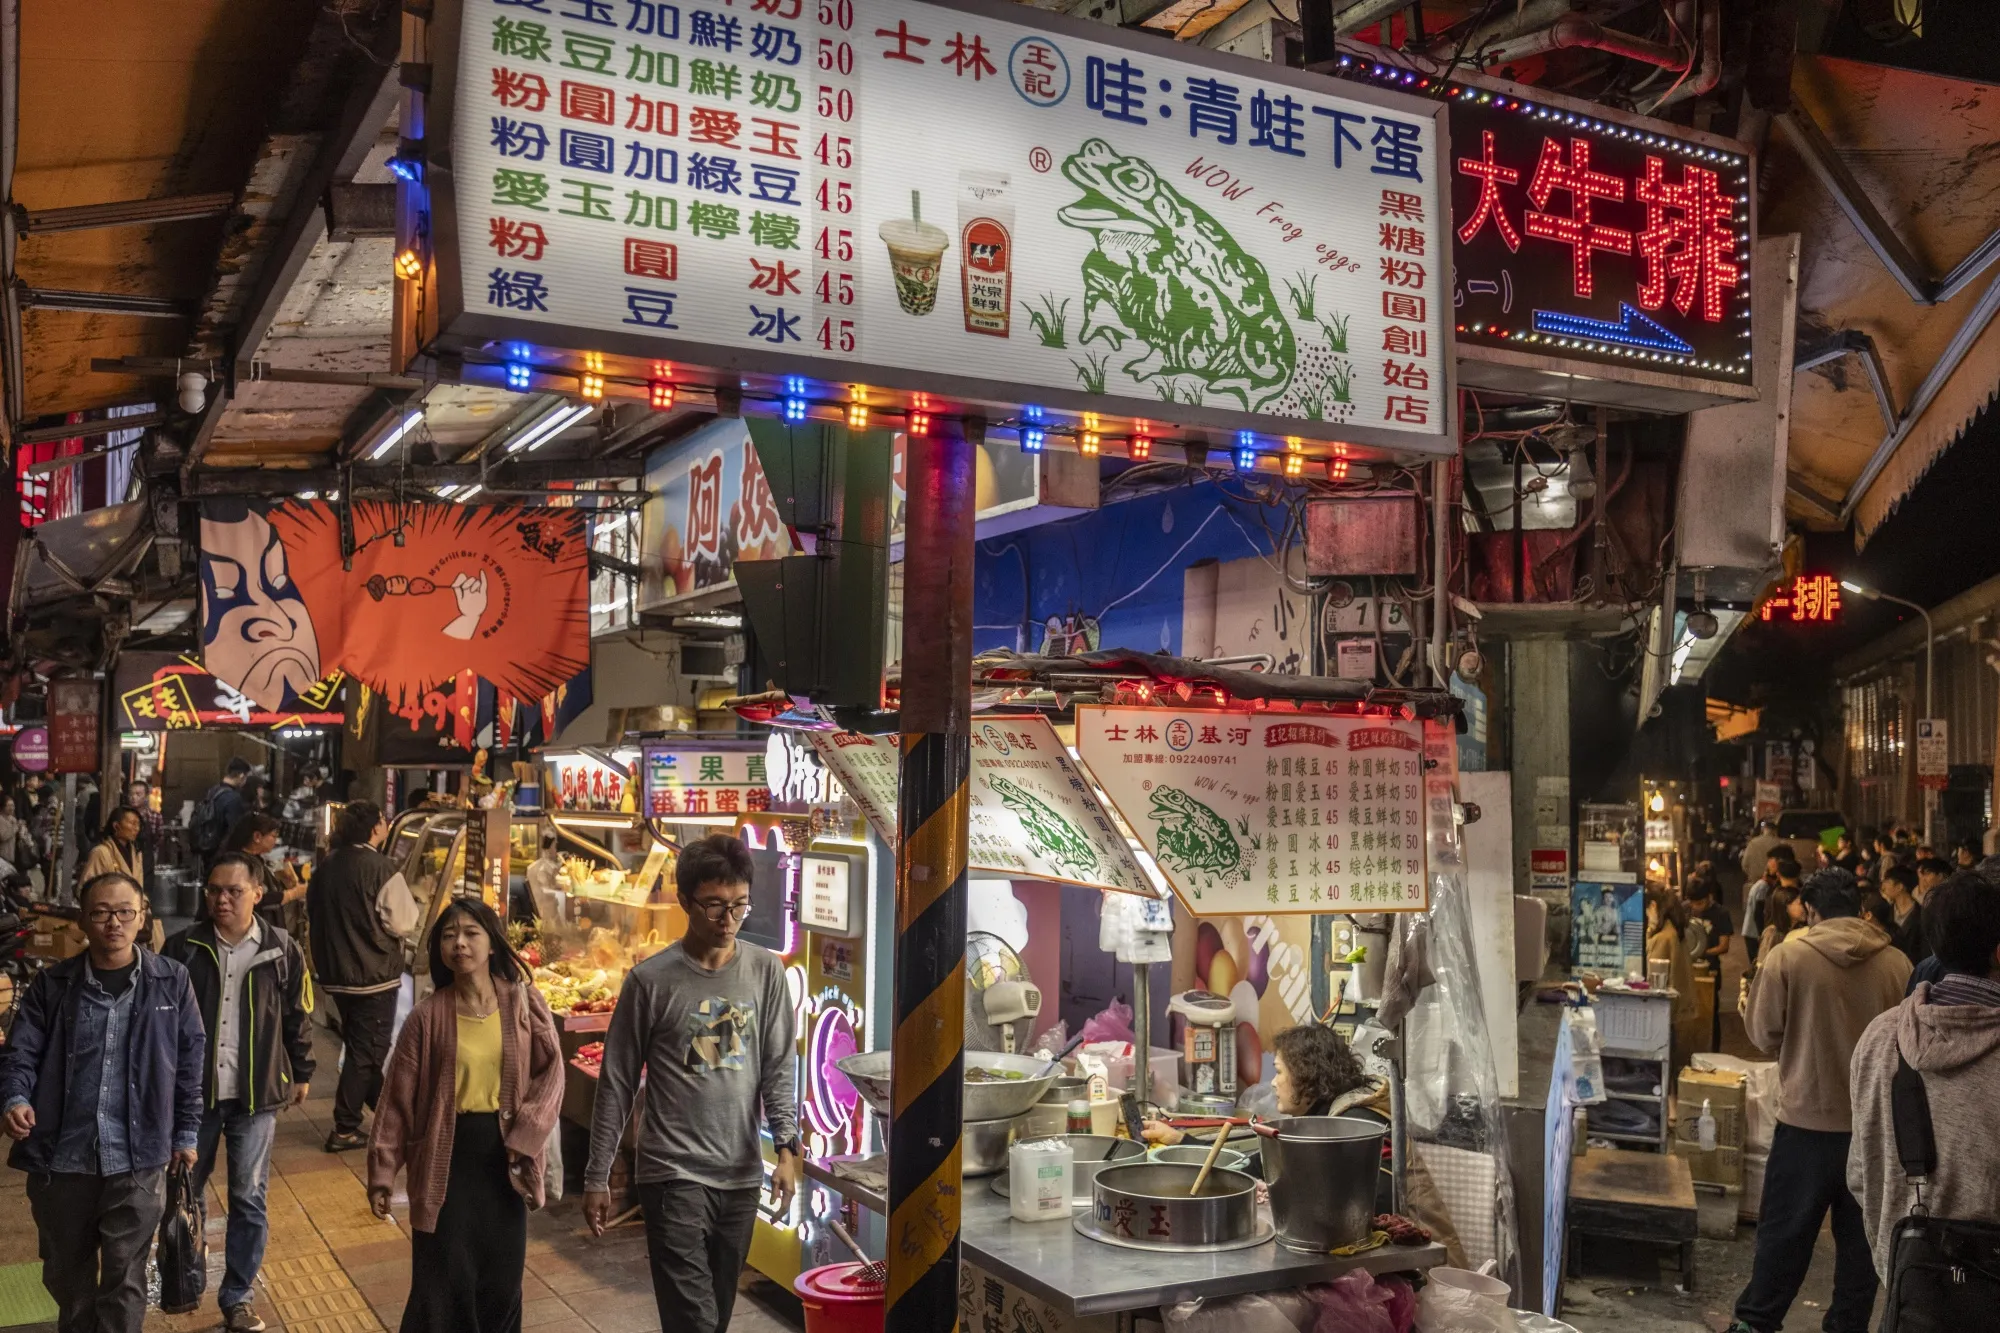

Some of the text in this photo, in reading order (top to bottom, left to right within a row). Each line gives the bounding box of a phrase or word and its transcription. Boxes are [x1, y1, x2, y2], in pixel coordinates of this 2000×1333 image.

[818, 0, 853, 31] 50
[818, 38, 853, 75] 50
[876, 20, 996, 81] 士林
[492, 15, 853, 122] 綠豆加鮮奶 50
[1022, 44, 1056, 100] 王記
[492, 67, 852, 169] 粉圓加愛玉 45
[491, 116, 852, 214] 粉圓加綠豆 45
[491, 167, 853, 261] 愛玉加檸檬 45
[1185, 156, 1361, 275] WOW Frog eggs
[1458, 130, 1738, 322] 大牛排
[814, 271, 854, 306] 45
[1379, 188, 1429, 426] 黑糖粉圓創始店
[815, 317, 855, 353] 45
[1105, 724, 1159, 743] 士林
[1172, 723, 1187, 747] 王記
[1198, 726, 1252, 746] 基河
[1326, 760, 1338, 775] 45
[1404, 760, 1417, 776] 50
[1326, 784, 1338, 800] 45
[1405, 784, 1417, 800] 50
[1326, 809, 1338, 825] 45
[1405, 810, 1418, 826] 50
[1326, 834, 1339, 850] 40
[1406, 834, 1418, 850] 50
[1326, 860, 1340, 874] 45
[1407, 860, 1419, 875] 50
[1327, 884, 1339, 900] 40
[1407, 884, 1419, 899] 50
